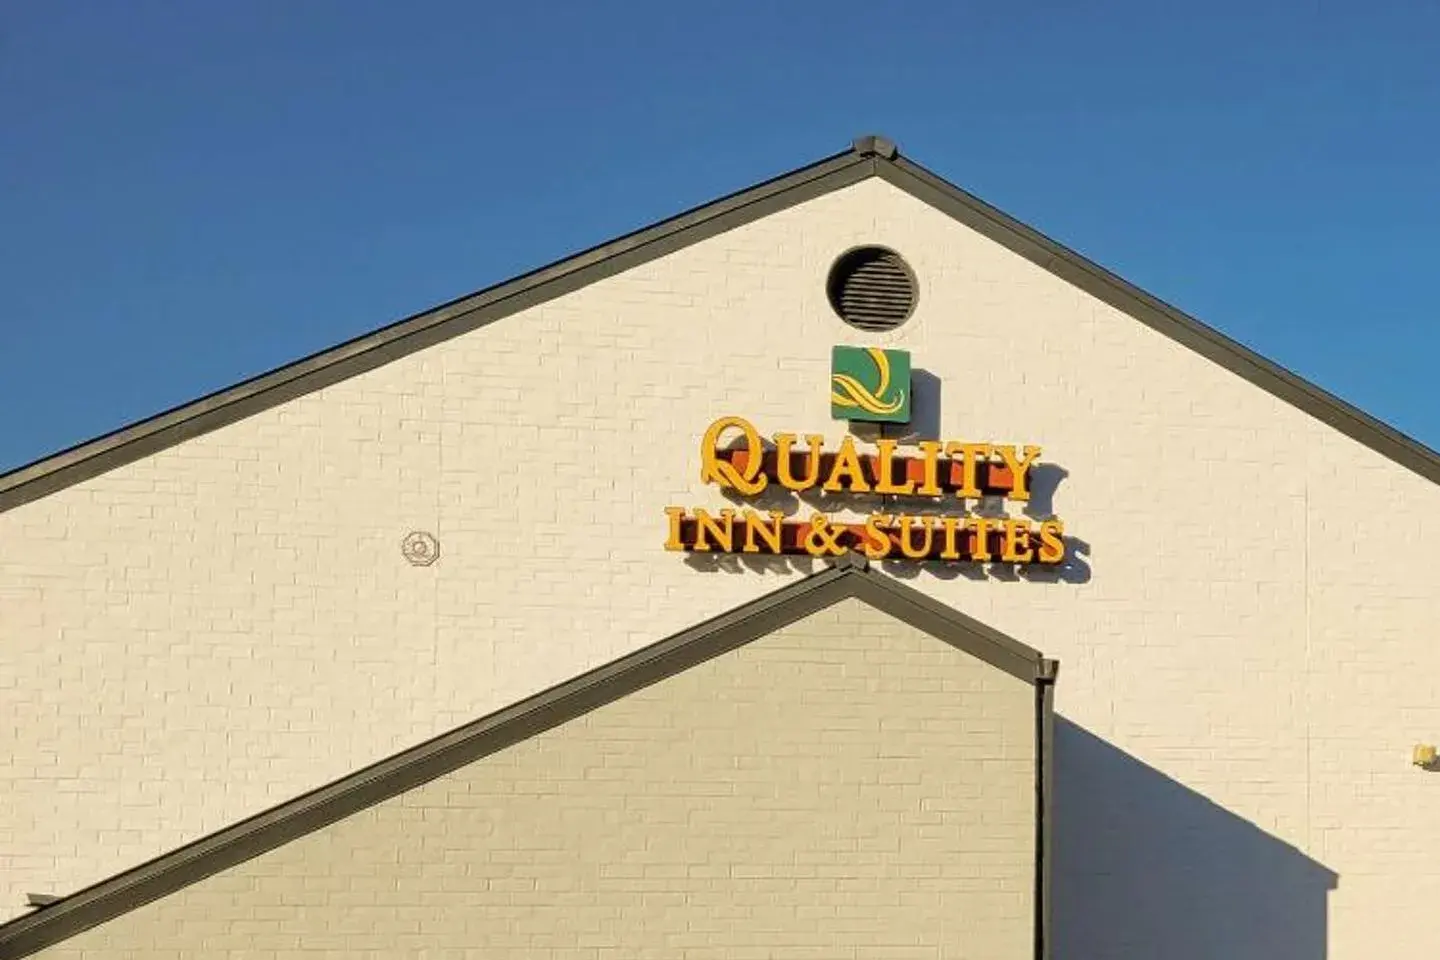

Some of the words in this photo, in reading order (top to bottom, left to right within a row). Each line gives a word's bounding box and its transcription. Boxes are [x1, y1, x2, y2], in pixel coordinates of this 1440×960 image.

[701, 415, 1042, 501] QUALITY
[664, 506, 786, 554] INN
[804, 511, 852, 556] &
[864, 512, 1065, 564] SUITES
